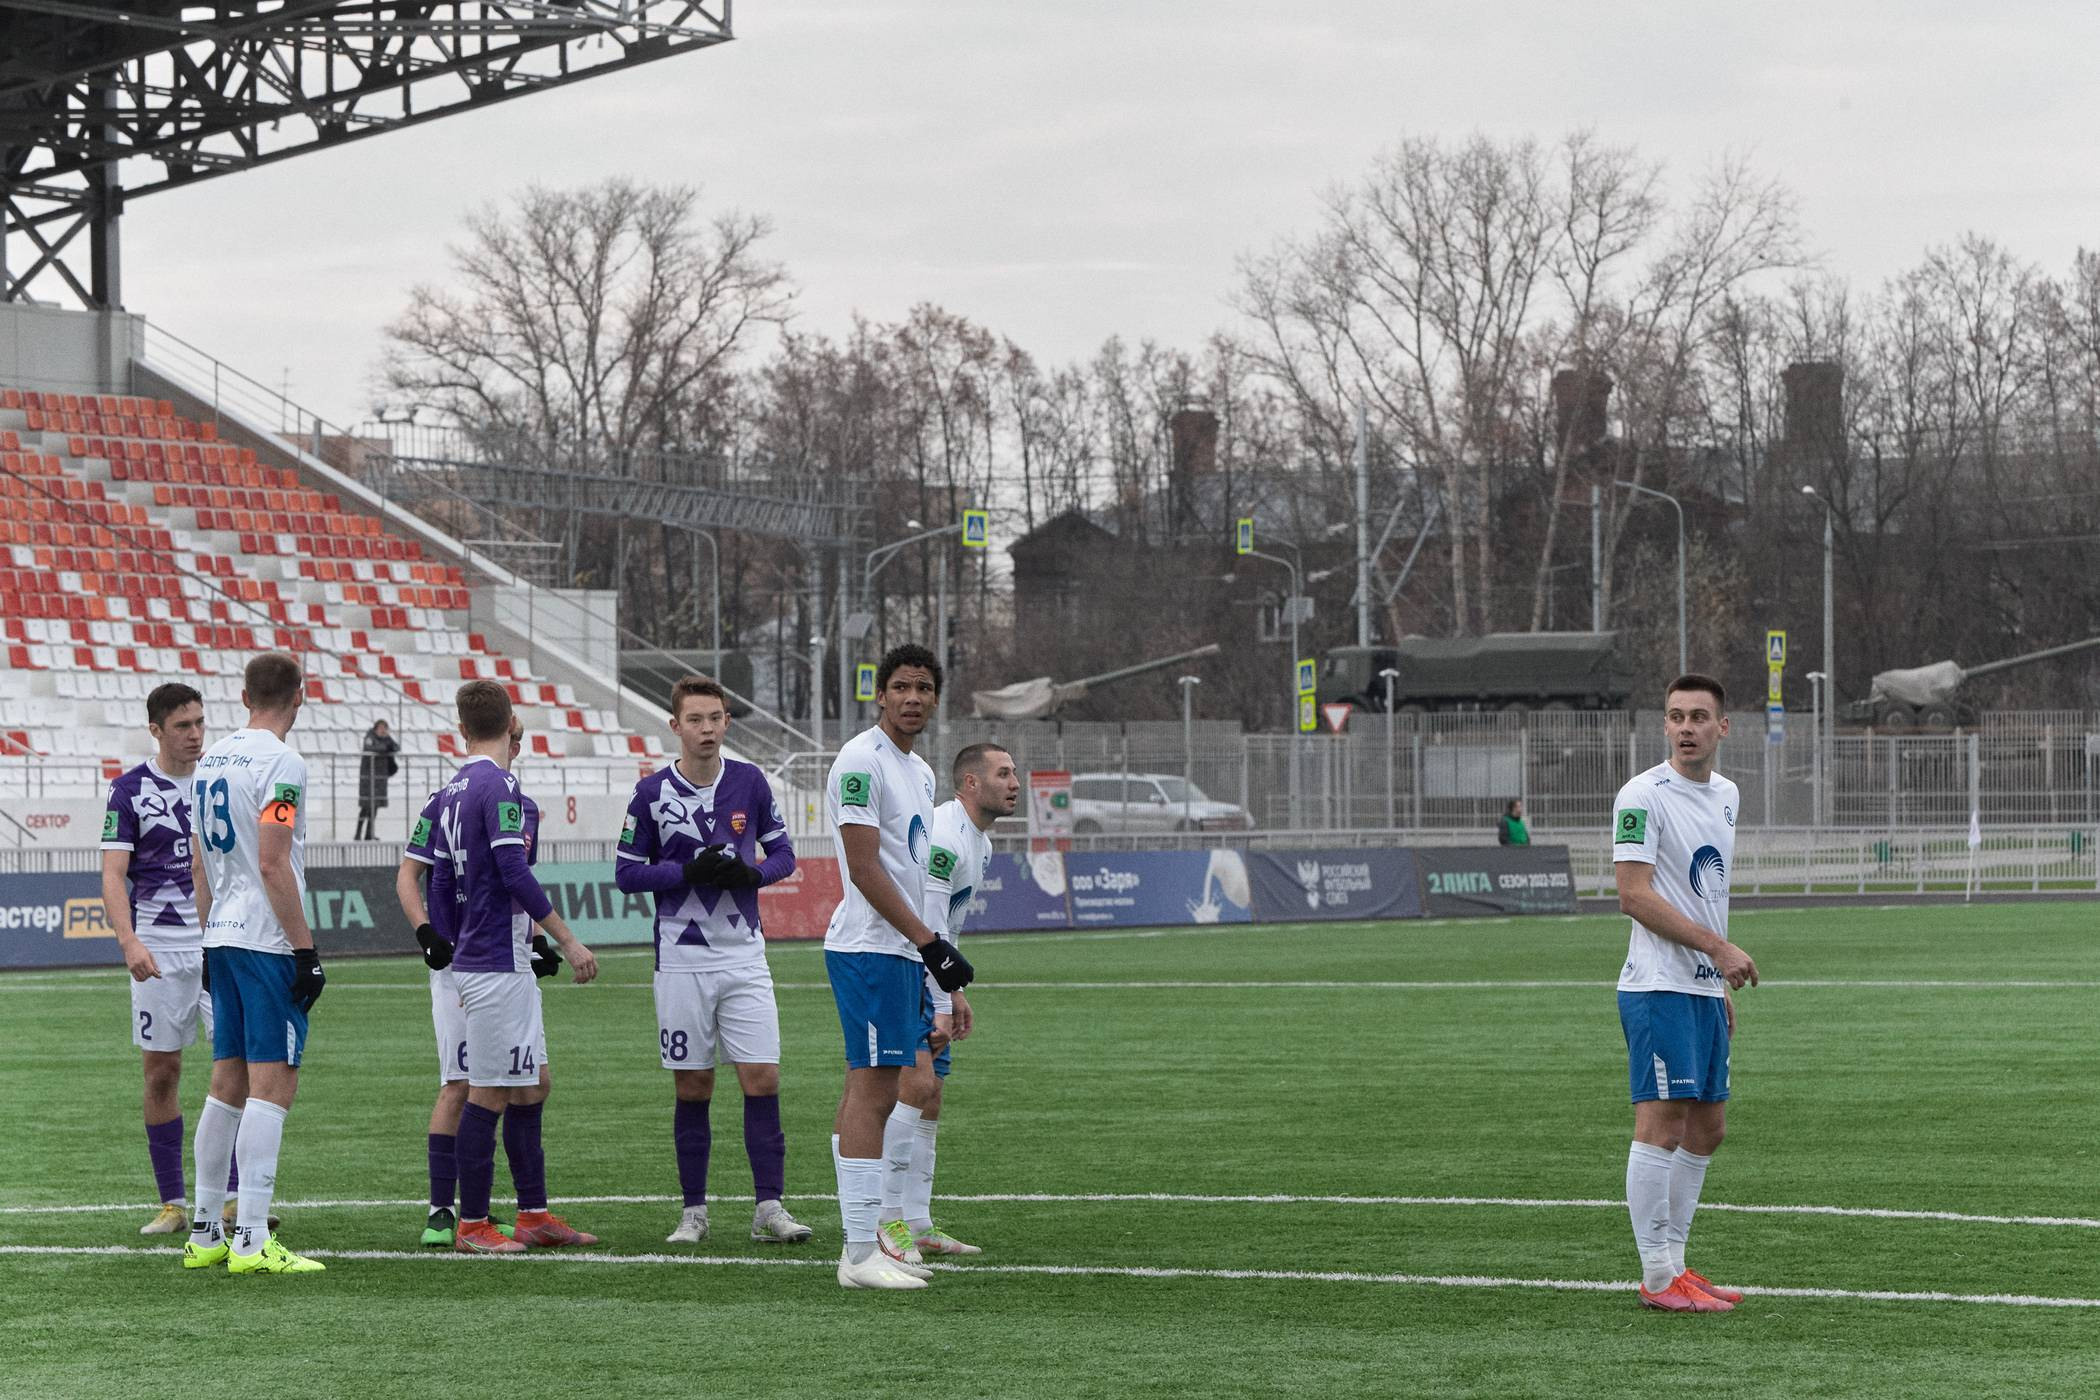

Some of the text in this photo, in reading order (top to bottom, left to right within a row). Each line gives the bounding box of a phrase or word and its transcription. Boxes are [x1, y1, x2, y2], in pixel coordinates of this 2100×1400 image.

[848, 780, 859, 791] 2
[25, 814, 71, 829] СЕКТОР
[196, 777, 236, 854] 13
[275, 803, 289, 823] C
[566, 796, 577, 824] 8
[1624, 817, 1635, 828] 2
[1498, 874, 1528, 889] СЕЗОН
[140, 1010, 152, 1041] 2
[660, 1028, 688, 1062] 98
[508, 1045, 535, 1076] 14
